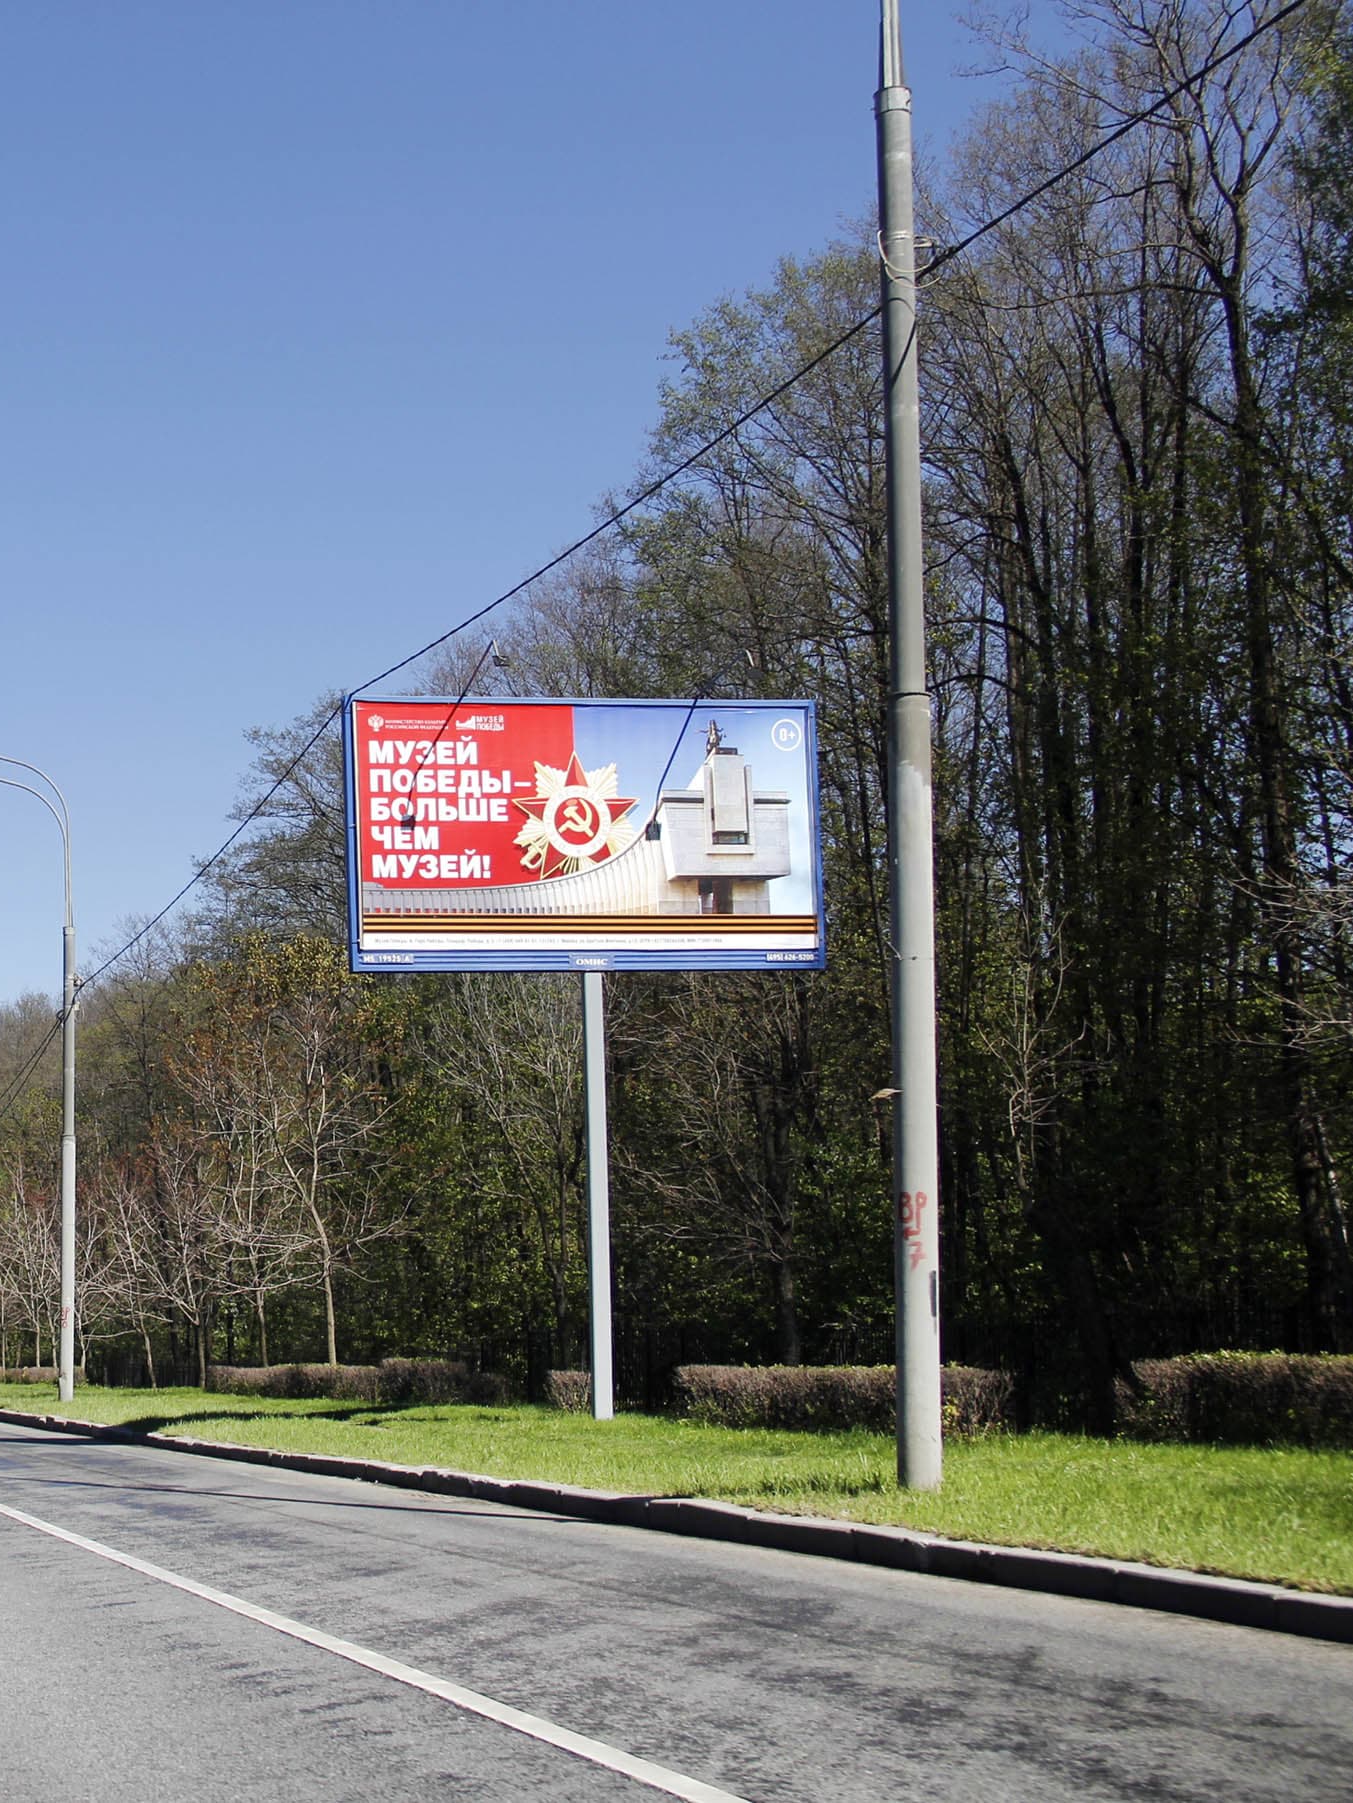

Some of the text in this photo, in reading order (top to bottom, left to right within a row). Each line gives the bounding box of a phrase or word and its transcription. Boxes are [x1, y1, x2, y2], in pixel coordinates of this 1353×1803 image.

[780, 728, 796, 741] 0+
[368, 735, 478, 765] МУЗЕЙ
[370, 797, 509, 822] БОЛЬШЕ
[371, 825, 440, 850] ЧЕМ
[371, 848, 492, 879] МУЗЕЙ!
